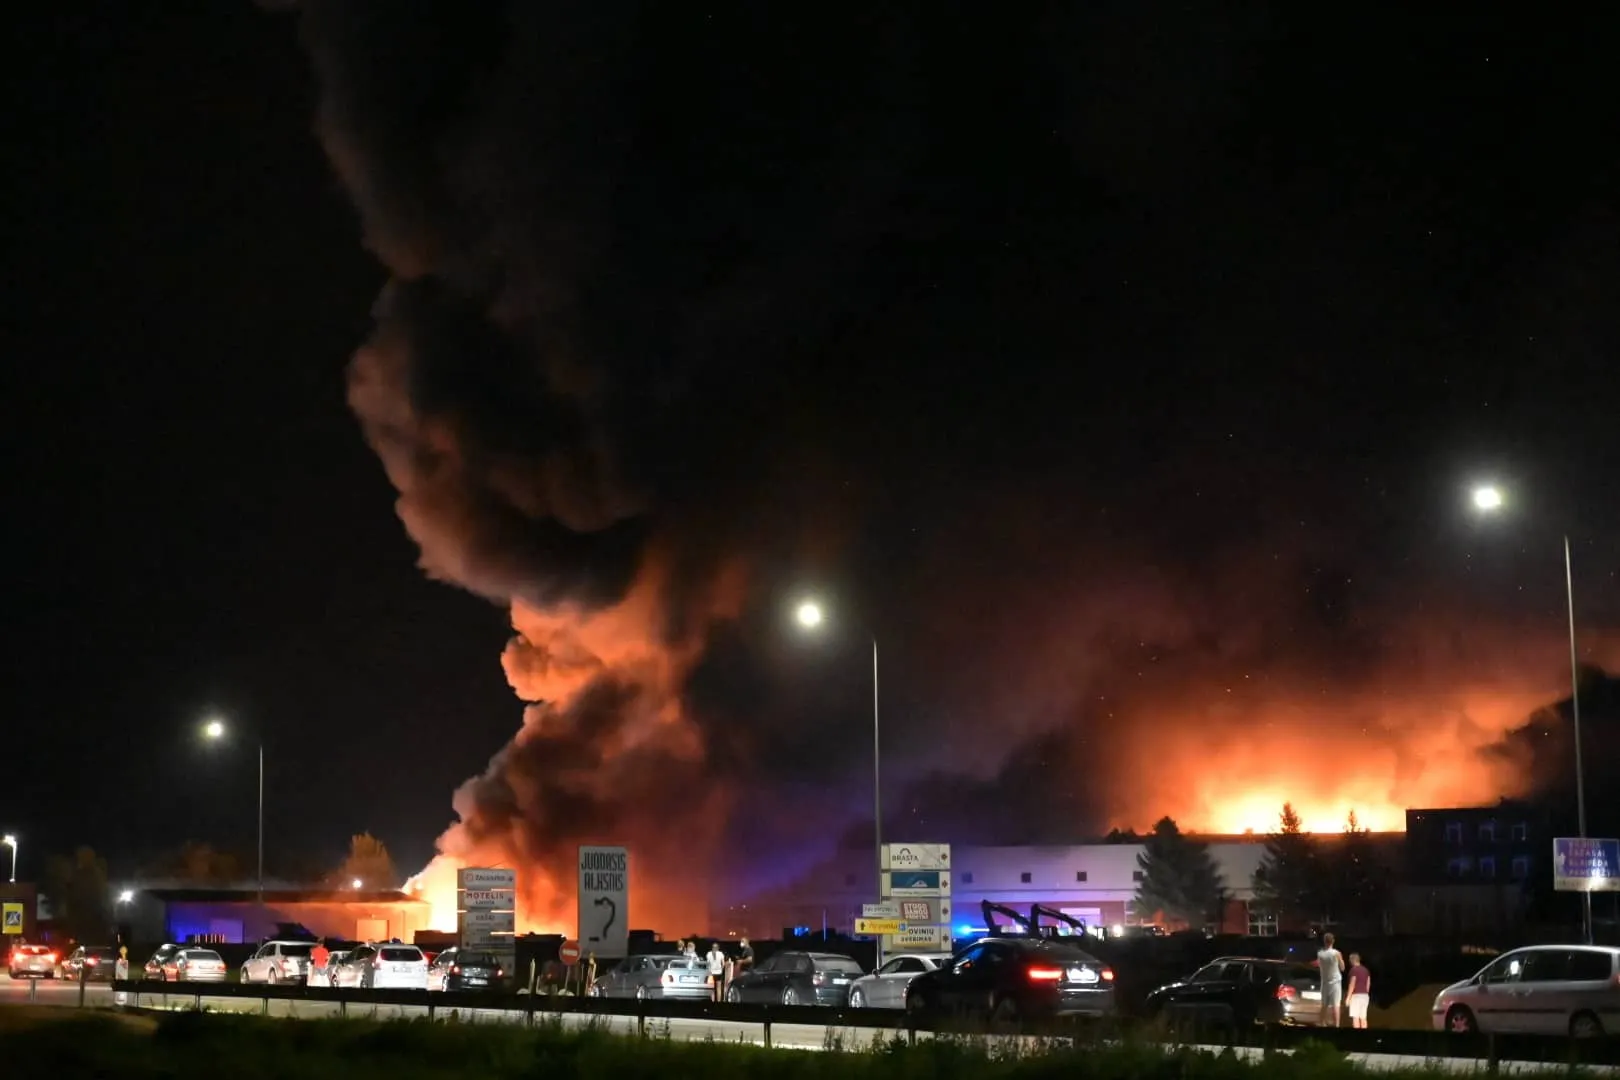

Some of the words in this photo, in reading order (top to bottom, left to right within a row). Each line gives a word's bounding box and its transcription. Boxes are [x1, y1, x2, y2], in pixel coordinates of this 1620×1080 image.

[581, 852, 626, 871] JUODASIS
[584, 872, 623, 892] ALKSNIS
[466, 892, 504, 900] MOTELIS
[908, 928, 934, 936] OVINIŲ
